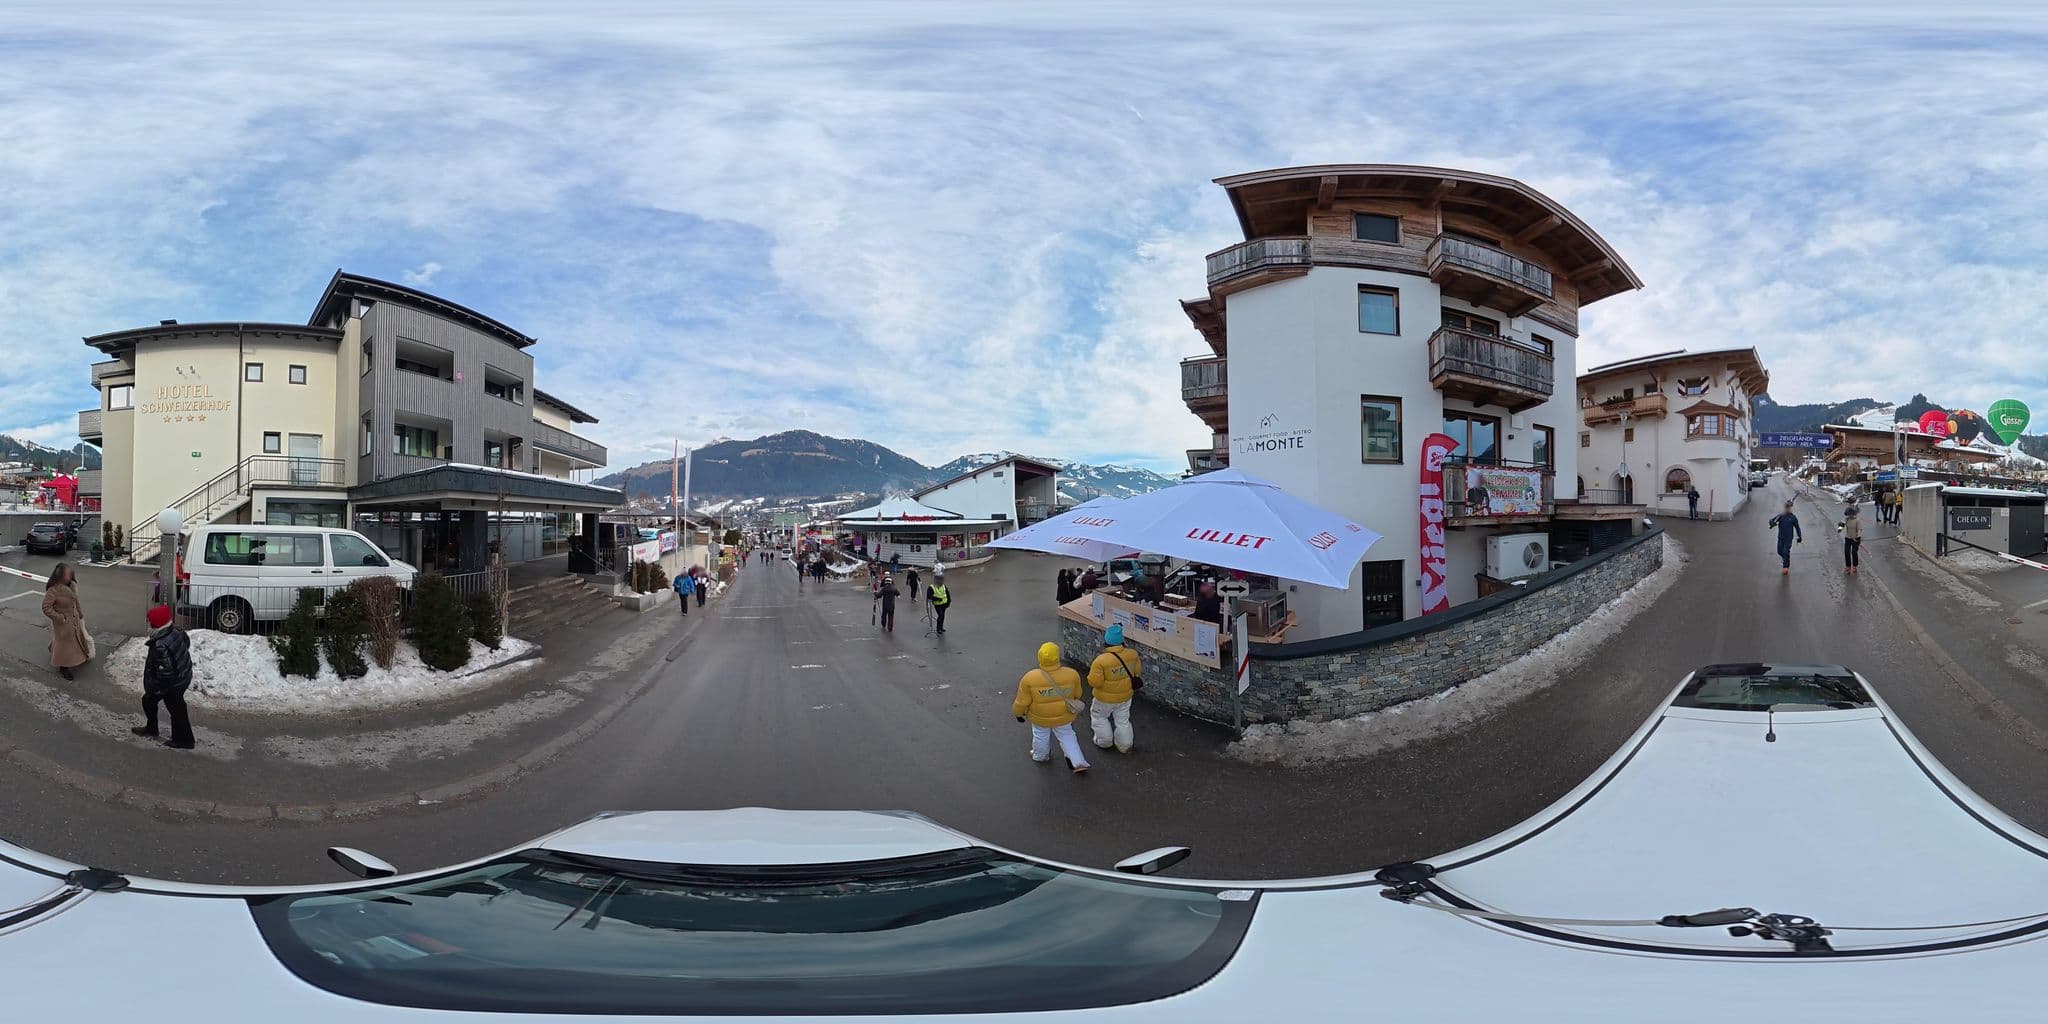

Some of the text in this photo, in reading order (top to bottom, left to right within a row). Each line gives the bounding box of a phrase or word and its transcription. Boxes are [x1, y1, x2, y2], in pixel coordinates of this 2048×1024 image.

[157, 384, 214, 399] HOTEL
[141, 400, 232, 414] SCHWEIZERHOF
[1240, 436, 1304, 453] LAMONTE
[1072, 516, 1115, 527] LILLET
[1956, 515, 1988, 523] CHECK-IN
[1186, 527, 1272, 549] LILLET
